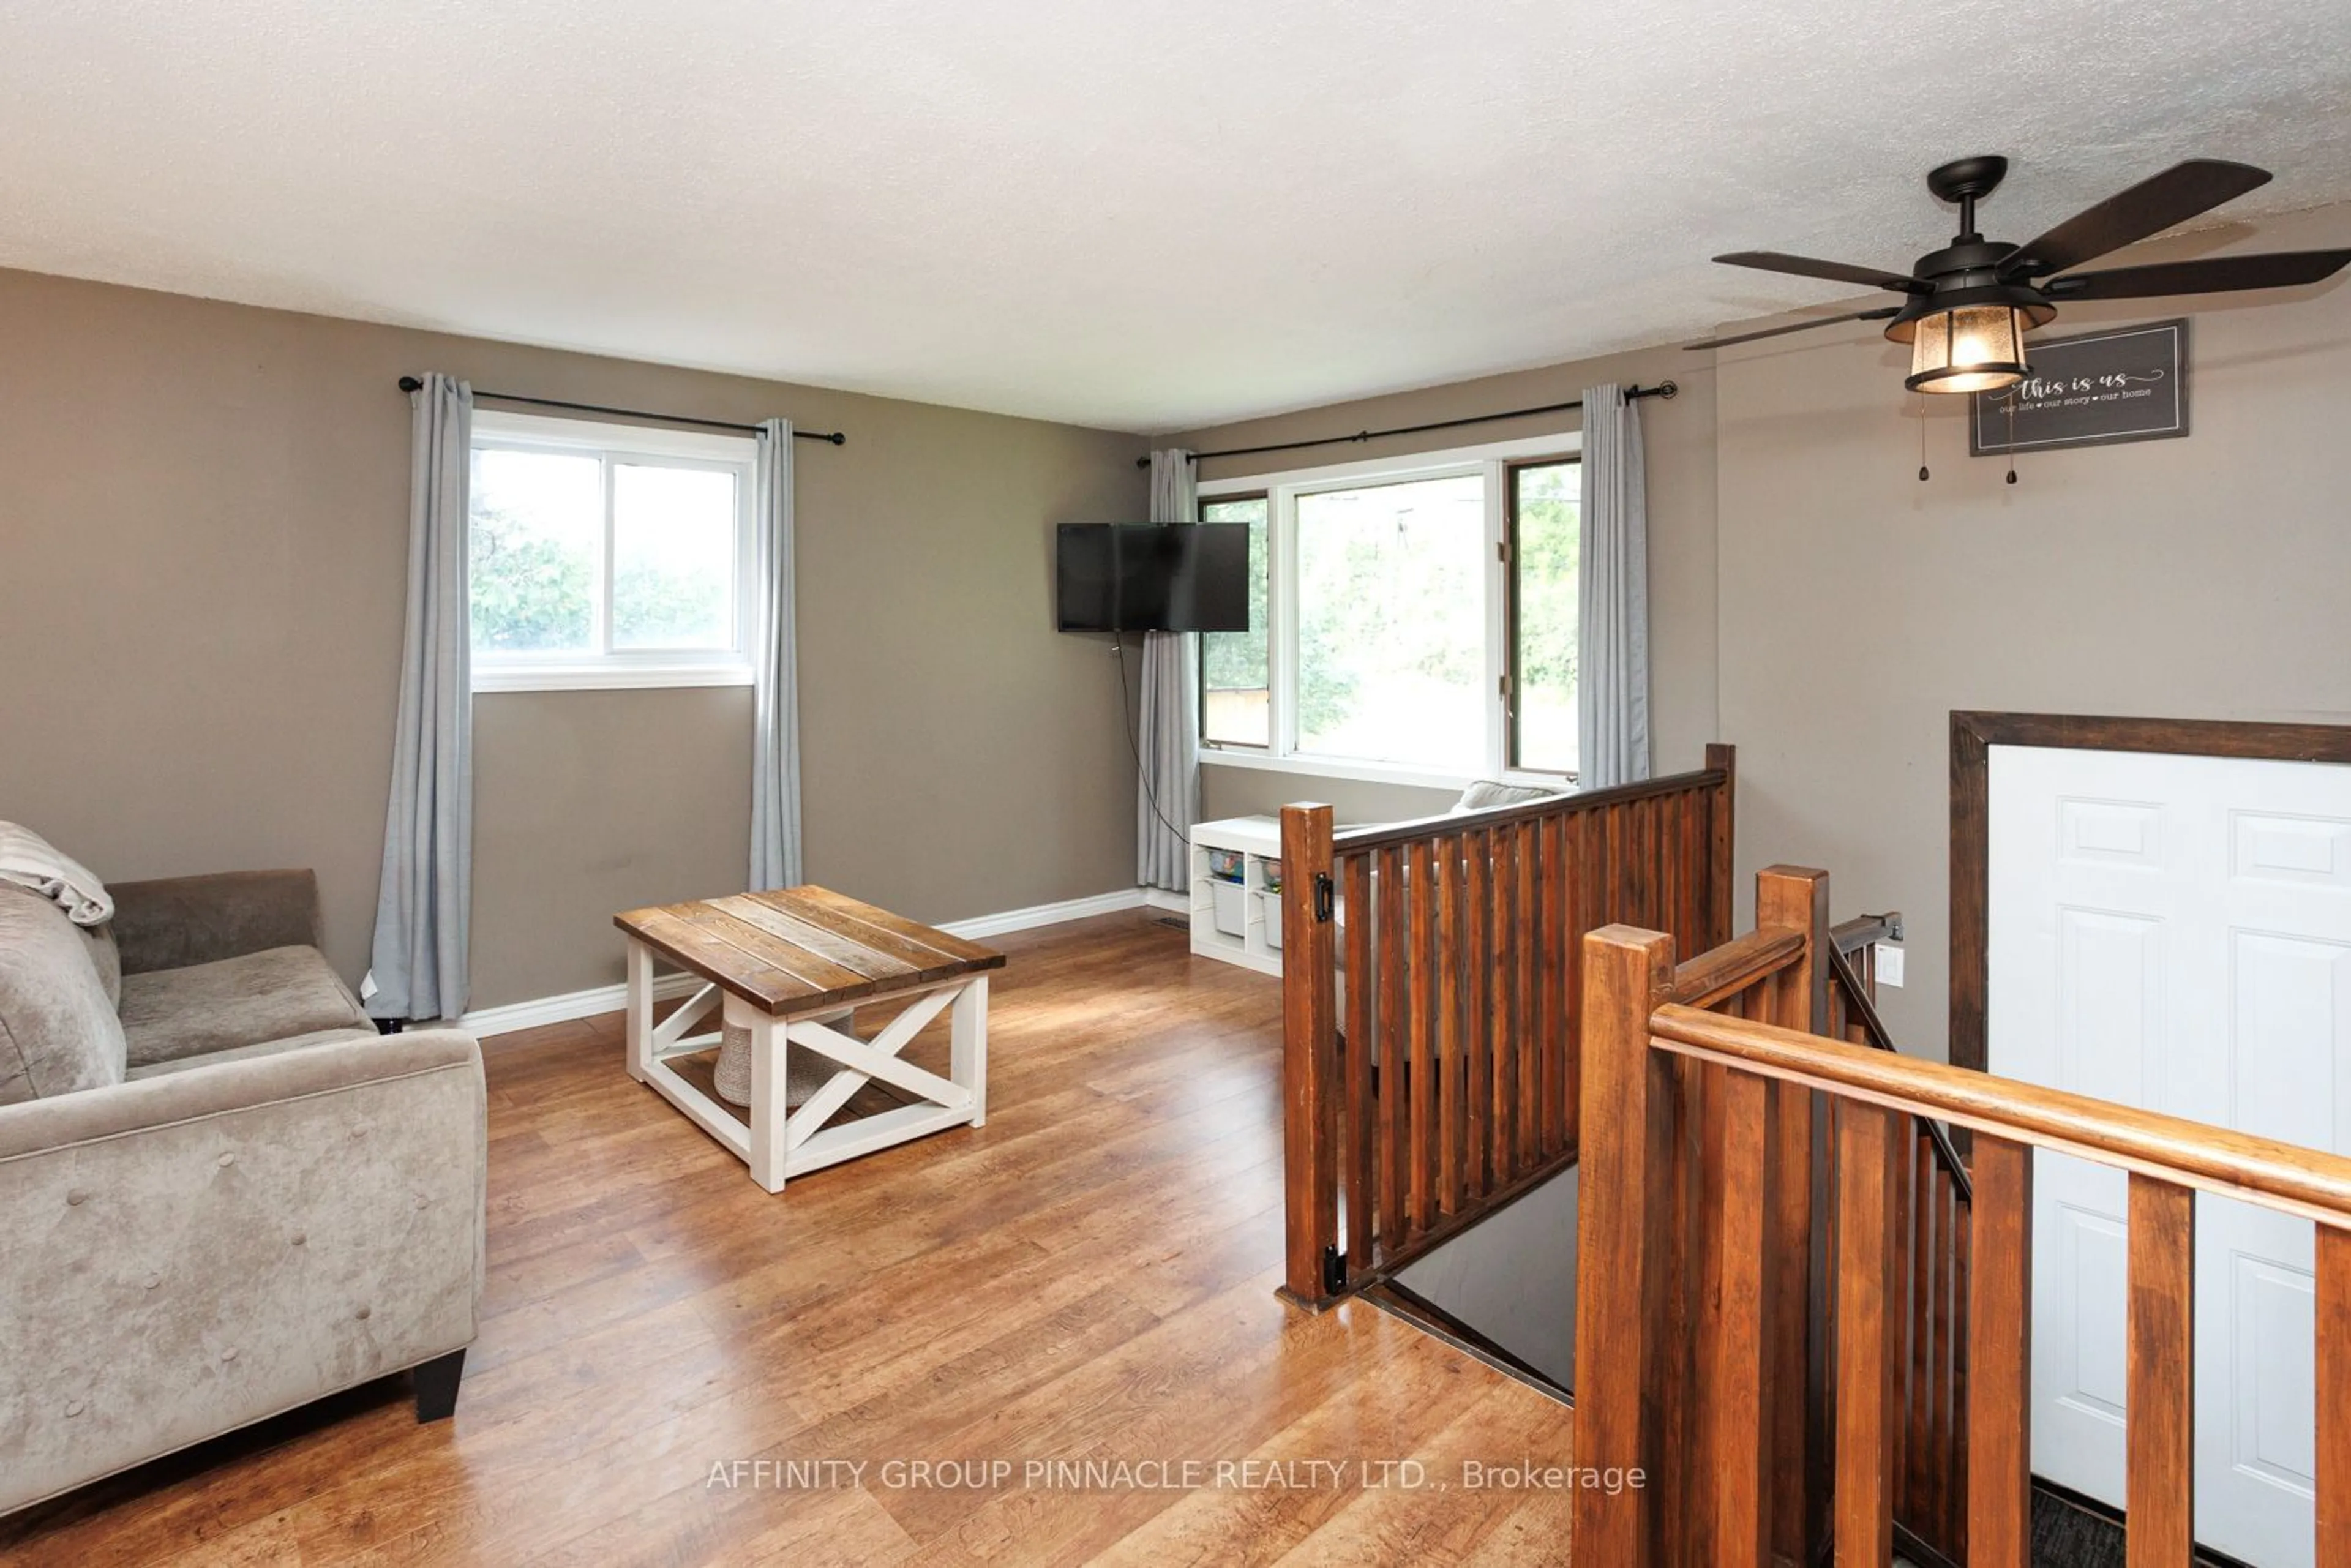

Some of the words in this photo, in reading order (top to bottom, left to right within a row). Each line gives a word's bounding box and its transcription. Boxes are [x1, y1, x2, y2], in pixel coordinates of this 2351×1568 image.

[2020, 377, 2068, 400] this
[2072, 377, 2094, 392] is
[1999, 405, 2017, 414] our
[2019, 402, 2034, 411] life
[2064, 396, 2090, 405] story
[2122, 389, 2151, 399] home
